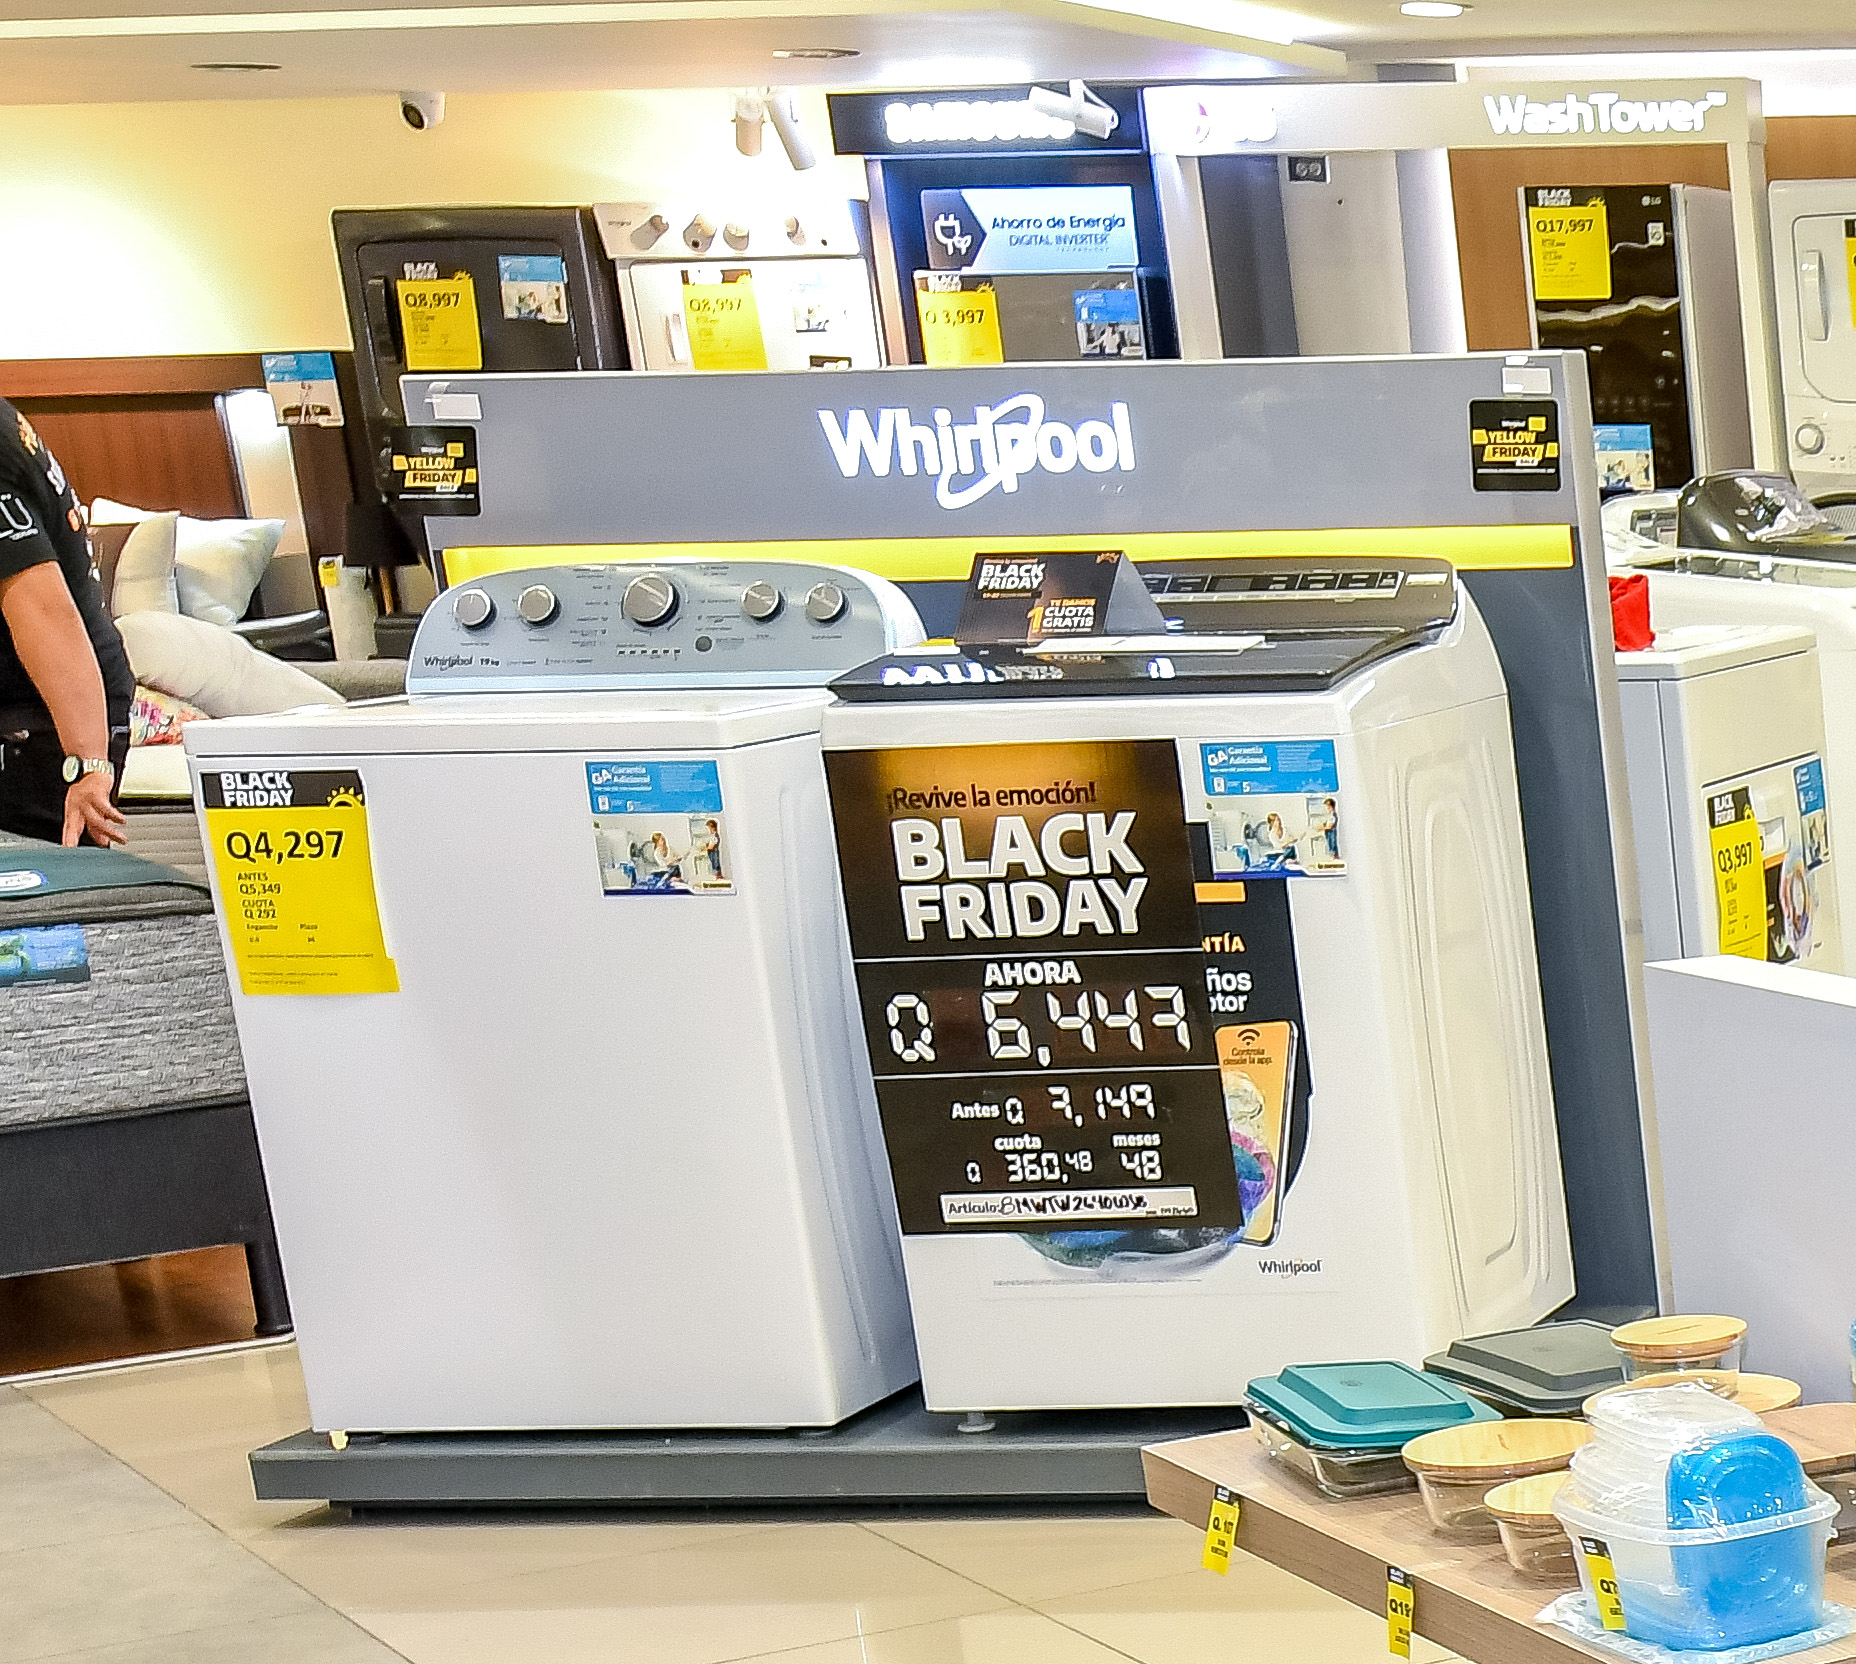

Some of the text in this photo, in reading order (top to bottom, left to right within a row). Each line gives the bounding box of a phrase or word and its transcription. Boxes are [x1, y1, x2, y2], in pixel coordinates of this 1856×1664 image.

[1484, 91, 1727, 135] WashTower
[992, 214, 1126, 232] Ahorro de Energía
[1536, 217, 1594, 235] Q17,997
[1489, 431, 1536, 443] YELLOW
[818, 392, 1136, 510] Whirlpool
[1492, 447, 1537, 458] FRIDAY
[413, 472, 457, 484] FRIDAY
[982, 563, 1046, 578] BLACK
[978, 576, 1044, 591] FRIDAY
[1027, 606, 1045, 634] 1
[1044, 606, 1094, 617] CUOTA
[1042, 616, 1094, 628] GRATIS
[220, 771, 293, 790] BLACK
[223, 789, 294, 807] FRIDAY
[886, 783, 1096, 813] ¡Revive la emoción!
[226, 829, 345, 864] Q4,297
[890, 811, 1145, 881] BLACK
[1717, 841, 1753, 874] Q3,997
[898, 877, 1150, 942] FRIDAY
[983, 961, 1082, 987] AHORA
[1205, 967, 1252, 992] ños
[885, 993, 937, 1063] Q
[951, 1102, 1000, 1120] Antes
[994, 1132, 1162, 1151] cuota meses
[1119, 1151, 1163, 1182] 48
[948, 1201, 1000, 1216] Artículo:
[1258, 1259, 1323, 1277] Whirlpool
